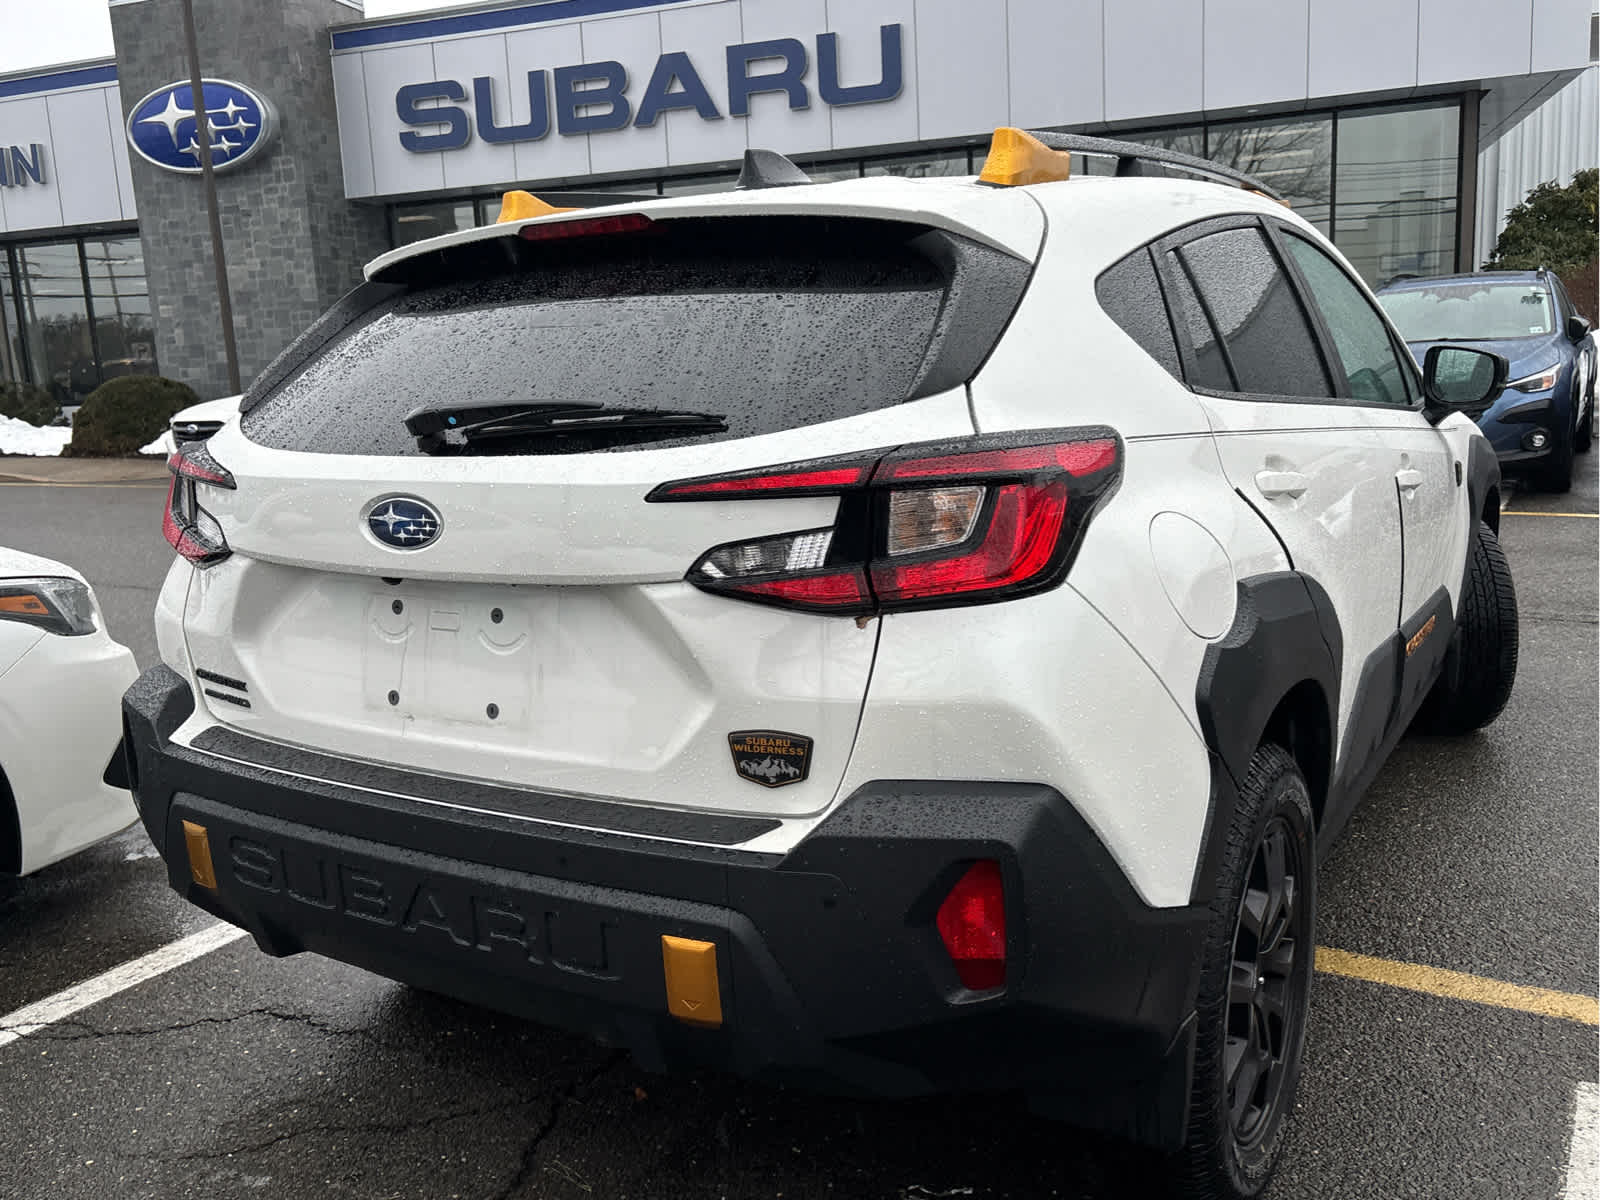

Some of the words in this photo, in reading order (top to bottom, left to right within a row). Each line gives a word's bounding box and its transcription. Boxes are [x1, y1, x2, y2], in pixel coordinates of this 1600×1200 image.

[396, 24, 903, 153] SUBARU
[735, 744, 804, 755] WILDERNESS
[746, 737, 791, 746] SUBARU
[230, 836, 622, 982] SUBARU
